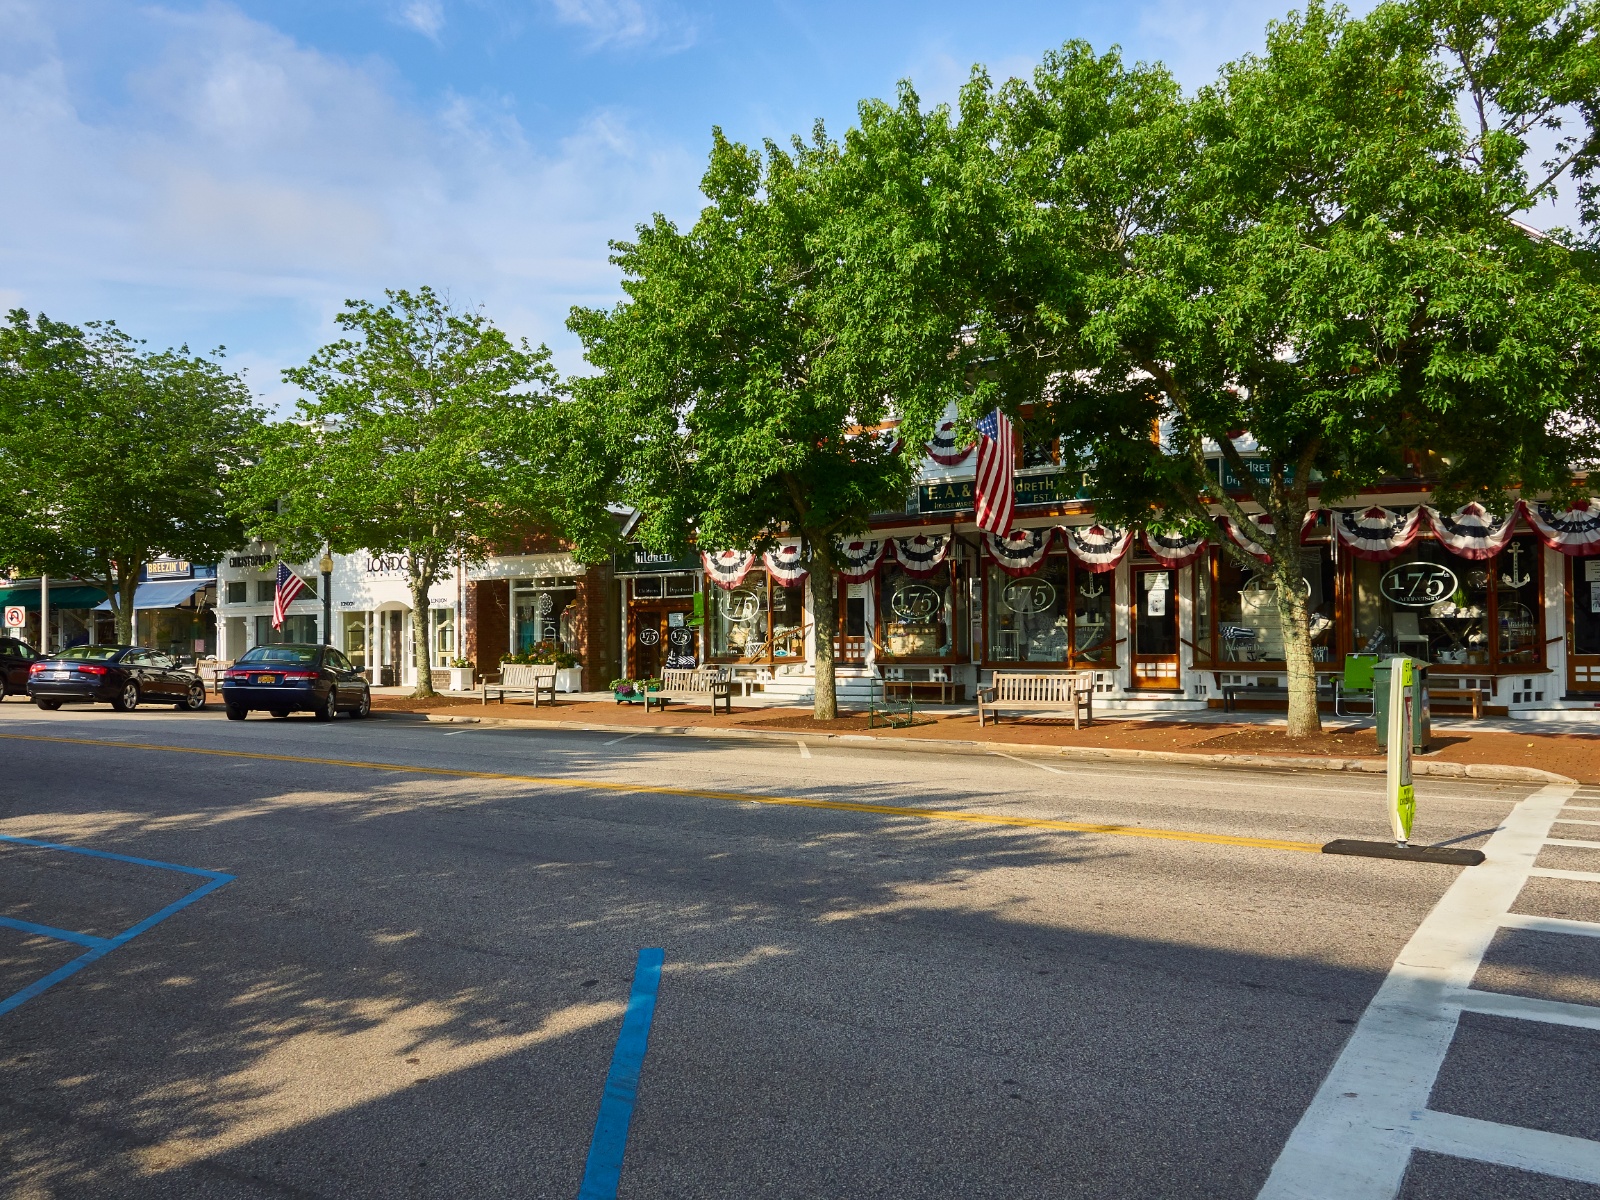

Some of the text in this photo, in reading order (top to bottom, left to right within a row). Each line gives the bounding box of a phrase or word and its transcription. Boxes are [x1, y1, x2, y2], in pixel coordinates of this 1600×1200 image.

[961, 483, 972, 497] &
[148, 561, 189, 573] BREEZIN' UP
[1007, 584, 1048, 606] 175
[897, 592, 934, 612] 175
[641, 631, 657, 642] 175
[672, 631, 688, 642] 175
